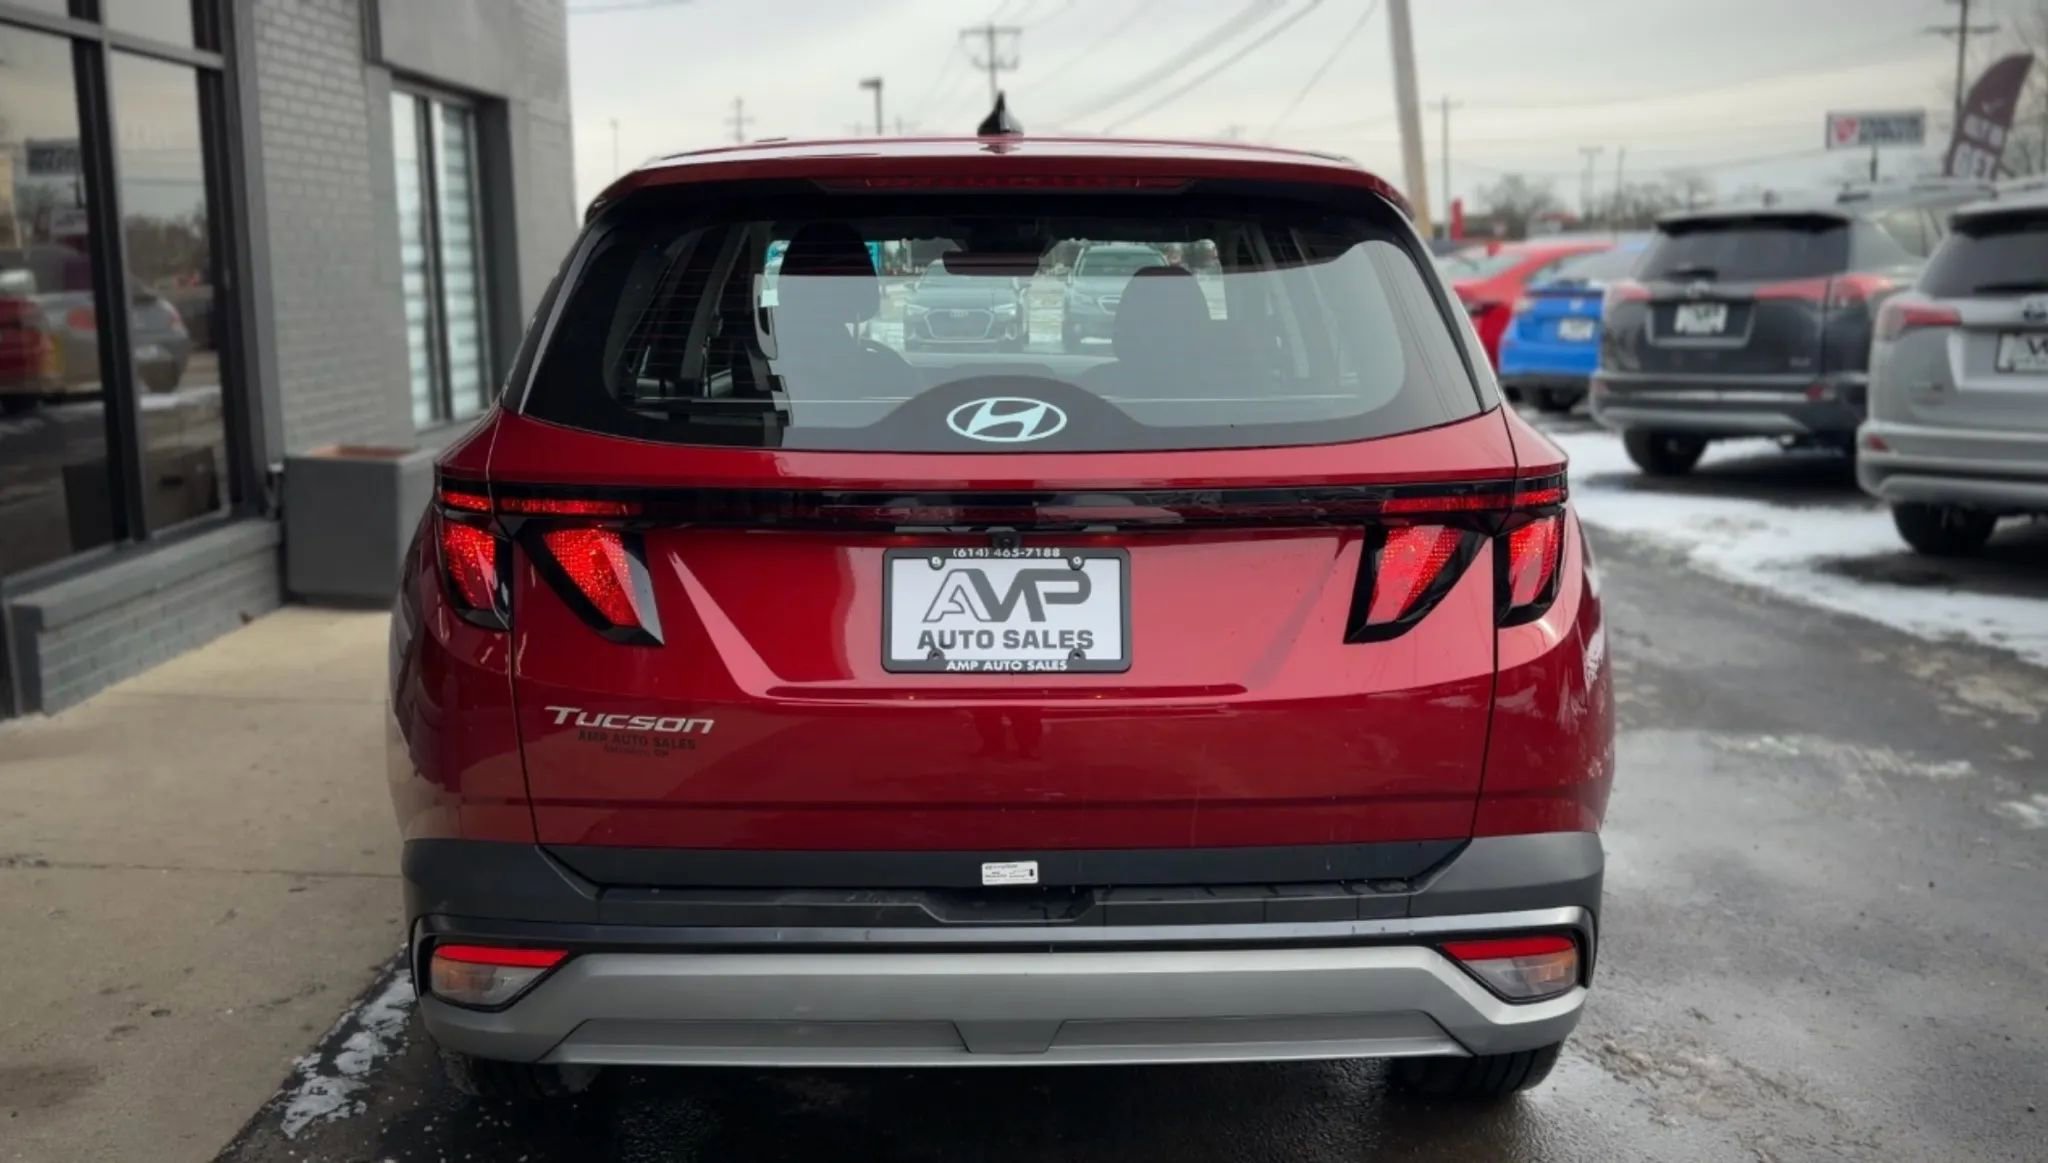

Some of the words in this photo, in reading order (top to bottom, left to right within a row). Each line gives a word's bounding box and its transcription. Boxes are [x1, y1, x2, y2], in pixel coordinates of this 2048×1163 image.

[952, 548, 990, 558] (614)
[993, 548, 1061, 558] 465-7188
[922, 567, 1092, 623] AMP
[917, 629, 995, 650] AUTO
[1003, 629, 1094, 650] SALES
[946, 660, 979, 671] AMP
[982, 660, 1024, 671] AUTO
[1026, 660, 1068, 671] SALES
[612, 734, 648, 746] AUTO
[653, 737, 697, 750] SALES
